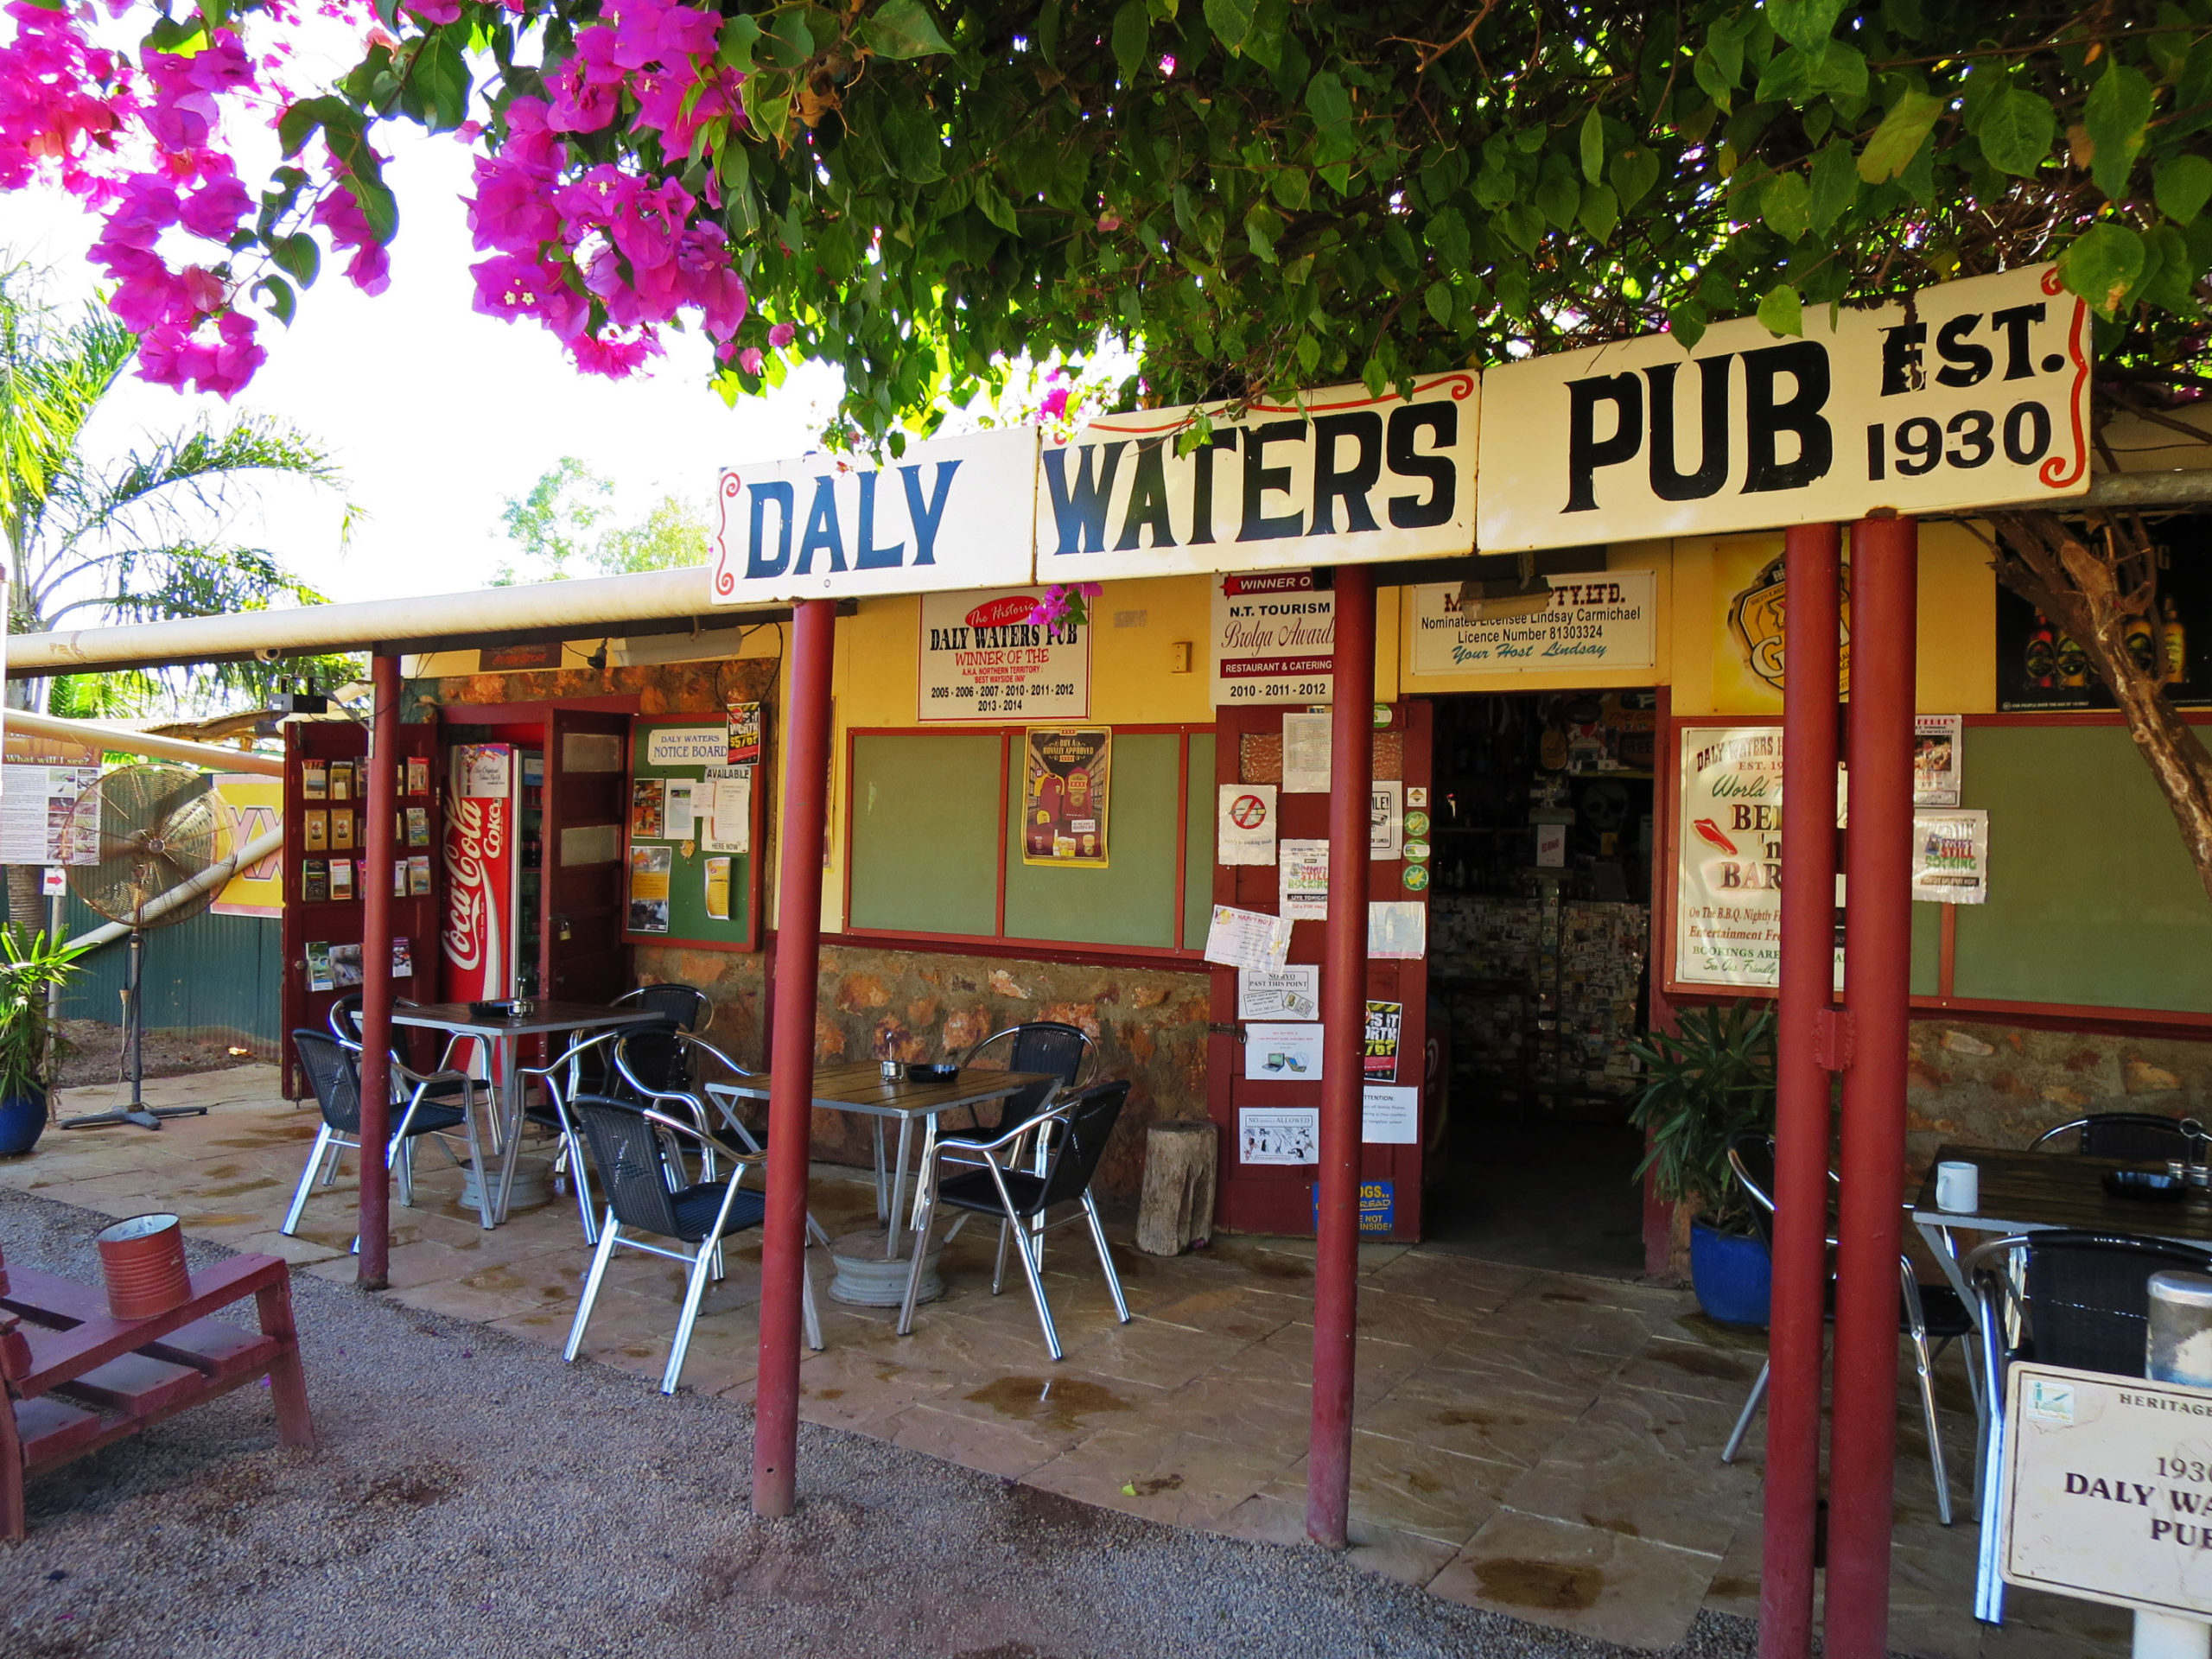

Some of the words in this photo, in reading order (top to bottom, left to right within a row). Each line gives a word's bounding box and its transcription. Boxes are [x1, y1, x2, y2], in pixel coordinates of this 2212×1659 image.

[1878, 302, 2065, 397] EST.
[1866, 401, 2053, 481] 1930
[743, 459, 964, 580] DALY
[1042, 399, 1461, 555] WATERS
[1560, 340, 1834, 513] PUB
[1241, 578, 1295, 590] WINNER
[970, 609, 988, 626] The
[993, 601, 1034, 625] Historic
[1230, 607, 1255, 617] N.T.
[1259, 602, 1331, 616] TOURISM
[1531, 610, 1573, 626] Lindsay
[1577, 607, 1641, 622] Carmichael
[930, 626, 969, 651] DALY
[974, 624, 1040, 650] WATERS
[1221, 620, 1273, 657] Brolga
[1458, 630, 1499, 644] Licence
[1503, 626, 1547, 641] Number
[1549, 625, 1603, 640] 81303324
[955, 651, 1003, 666] WINNER
[1007, 650, 1021, 664] OF
[1026, 648, 1049, 664] THE
[1452, 645, 1491, 665] Your
[1495, 643, 1534, 658] Host
[1541, 642, 1608, 659] Lindsay
[978, 666, 1008, 675] NORTHERN
[1010, 664, 1040, 674] TERRITORY
[1225, 662, 1280, 673] RESTAURANT
[1289, 660, 1332, 671] CATERING
[990, 675, 1013, 683] WAYSIDE
[931, 687, 949, 698] 2005
[956, 686, 974, 697] 2006
[980, 685, 999, 696] 2007
[1006, 685, 1025, 696] 2010
[1031, 684, 1049, 696] 2011
[1056, 683, 1074, 695] 2012
[1230, 685, 1255, 696] 2010
[1265, 684, 1289, 696] 2011
[1299, 683, 1325, 695] 2012
[978, 700, 996, 711] 2013
[1003, 699, 1022, 711] 2014
[5, 753, 35, 763] What
[36, 755, 56, 764] will
[654, 746, 689, 758] NOTICE
[692, 746, 728, 758] BOARD
[1697, 741, 1725, 772] DALY
[1728, 735, 1773, 760] WATERS
[1738, 760, 1766, 771] EST.
[707, 769, 749, 779] AVAILABLE
[1712, 773, 1770, 798] World
[483, 801, 503, 859] Coke
[1941, 847, 1977, 858] STILL
[442, 791, 482, 970] Coca-Cola
[1689, 906, 1700, 918] On
[1702, 907, 1716, 918] The
[1717, 907, 1741, 922] B.B.Q.
[1744, 908, 1771, 925] Nightly
[1692, 946, 1754, 957] BOOKINGS
[1386, 1014, 1399, 1028] IT
[1360, 1223, 1392, 1231] INSIDE!
[2064, 1471, 2158, 1507] DALY
